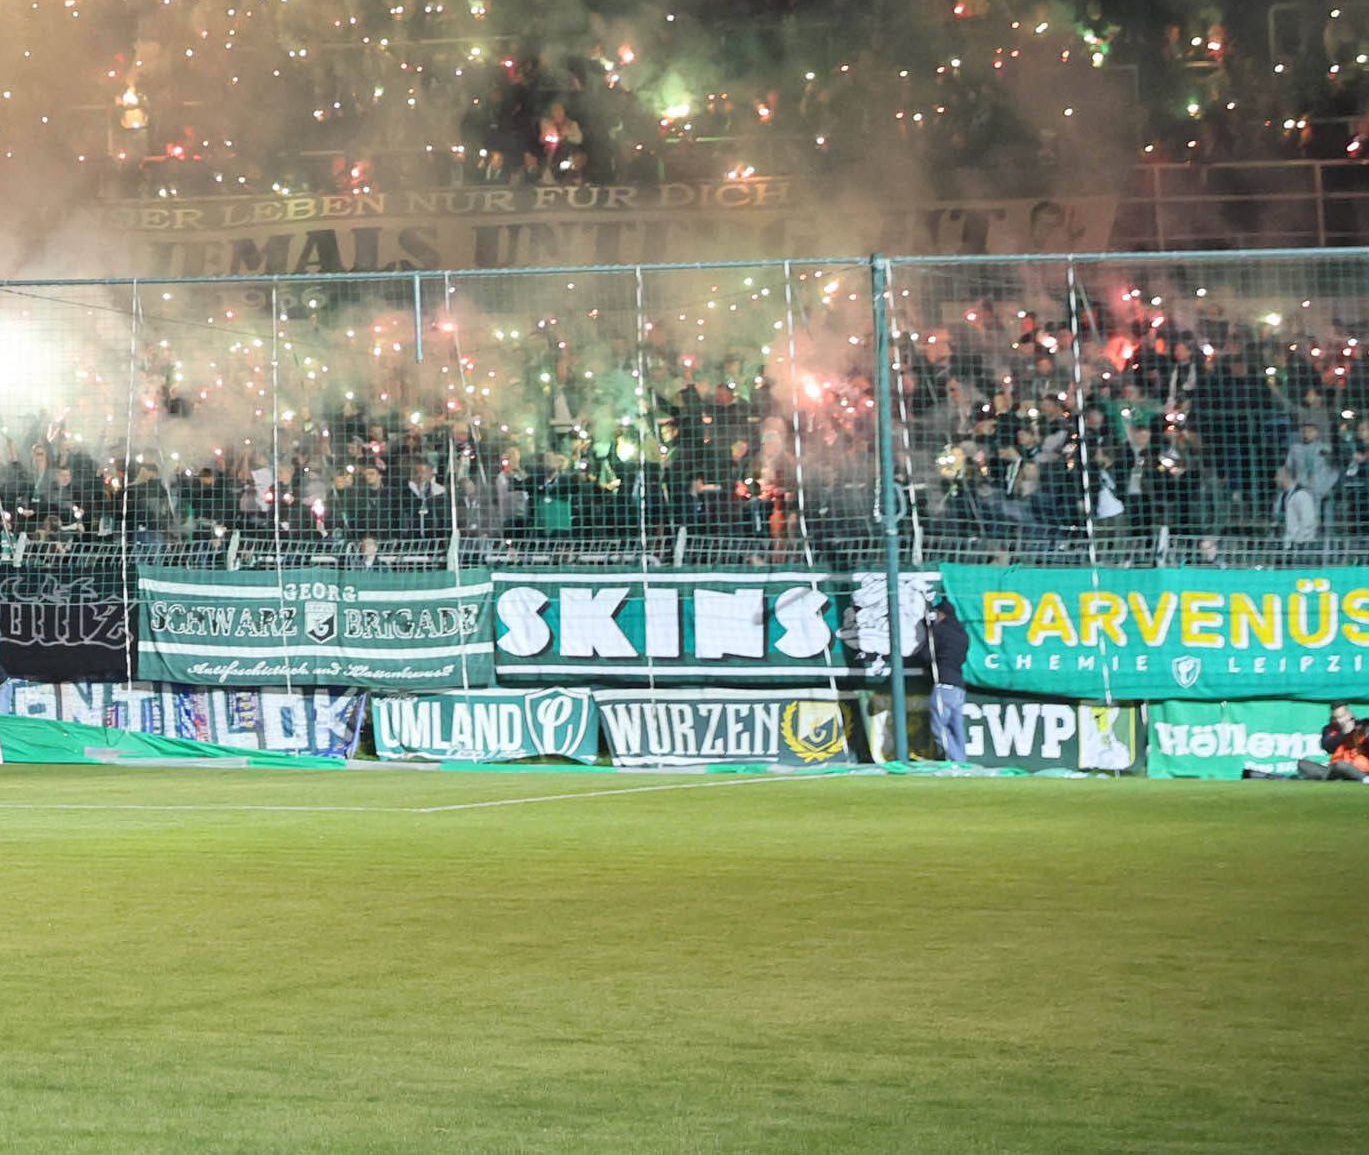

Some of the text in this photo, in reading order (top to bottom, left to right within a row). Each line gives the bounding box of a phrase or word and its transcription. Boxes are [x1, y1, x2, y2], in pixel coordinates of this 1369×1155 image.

[224, 191, 389, 224] LEBEN
[407, 189, 518, 215] NUR
[533, 182, 638, 210] FÜR
[660, 180, 792, 209] DICH
[284, 581, 357, 602] GEORG
[982, 578, 1369, 651] PARVENÜS
[151, 600, 299, 638] SCHWARZ
[343, 604, 479, 640] BRIGADE
[496, 586, 831, 658] SKINS
[983, 653, 1150, 672] CHEMIE
[380, 698, 524, 752] UMLAND
[600, 702, 781, 757] WURZEN
